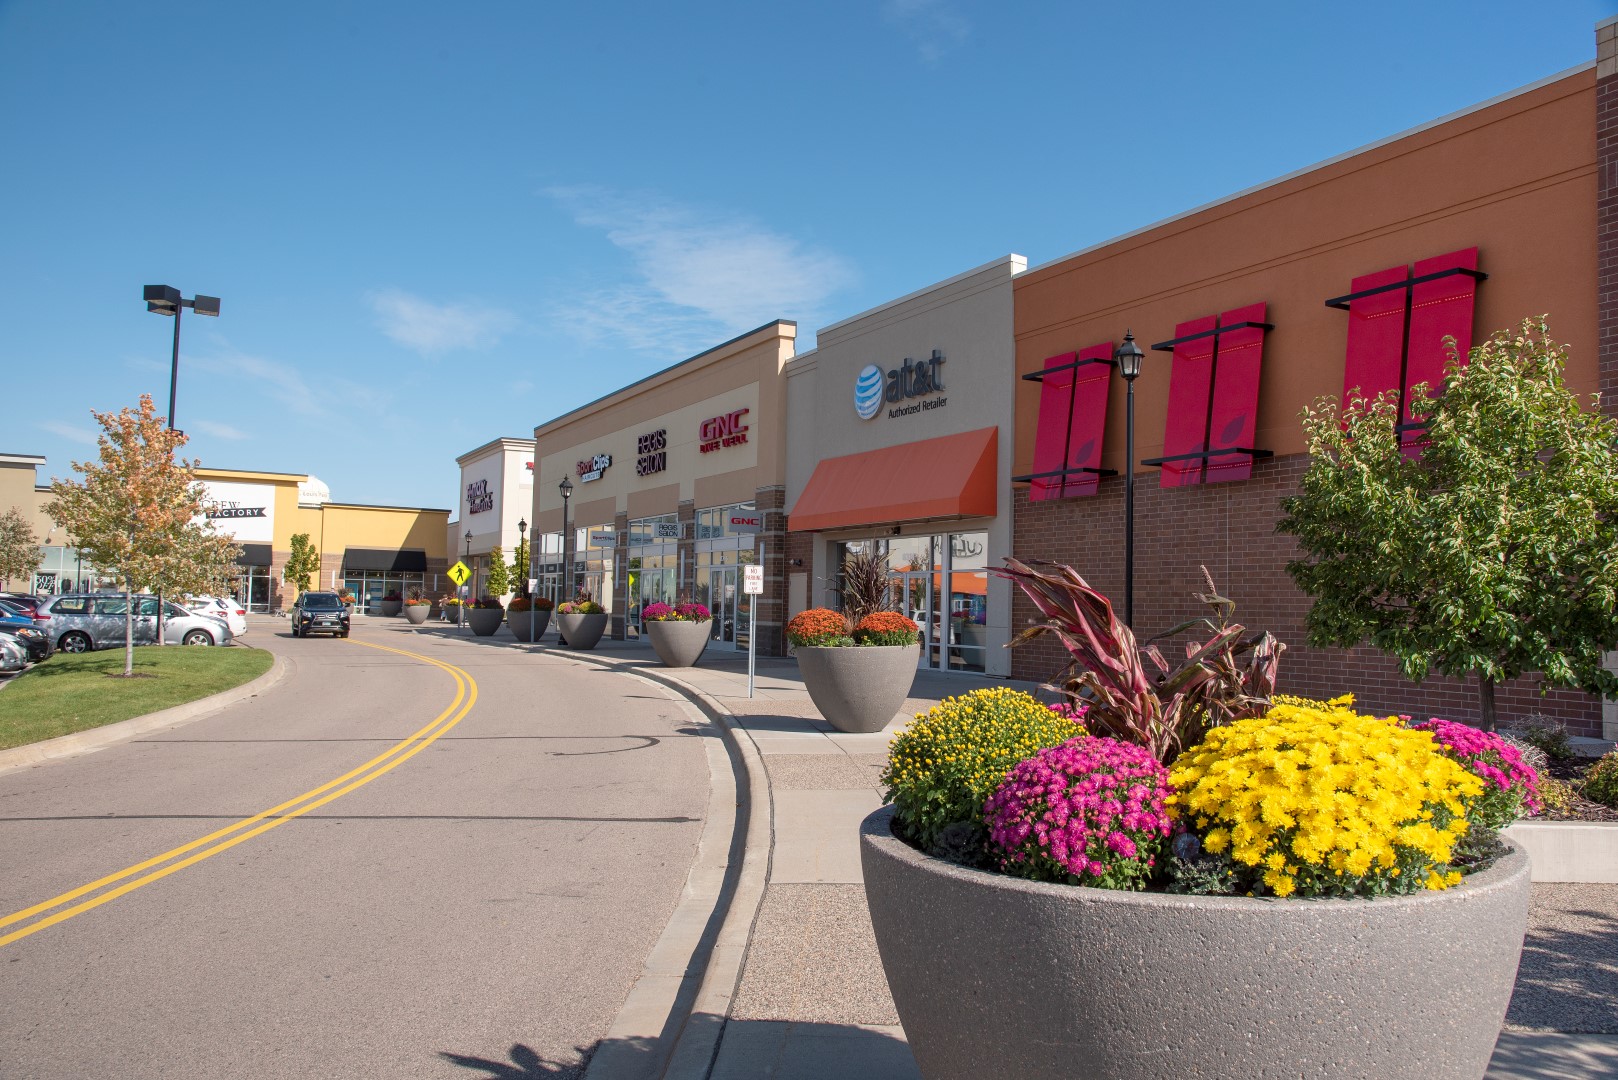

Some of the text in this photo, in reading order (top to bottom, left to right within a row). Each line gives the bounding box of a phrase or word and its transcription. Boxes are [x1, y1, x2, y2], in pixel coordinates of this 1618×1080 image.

[886, 349, 946, 402] at&t
[888, 396, 948, 419] Authorized Retailer
[699, 408, 749, 442] GNC
[210, 509, 259, 518] FACTORY
[731, 517, 759, 525] GNC
